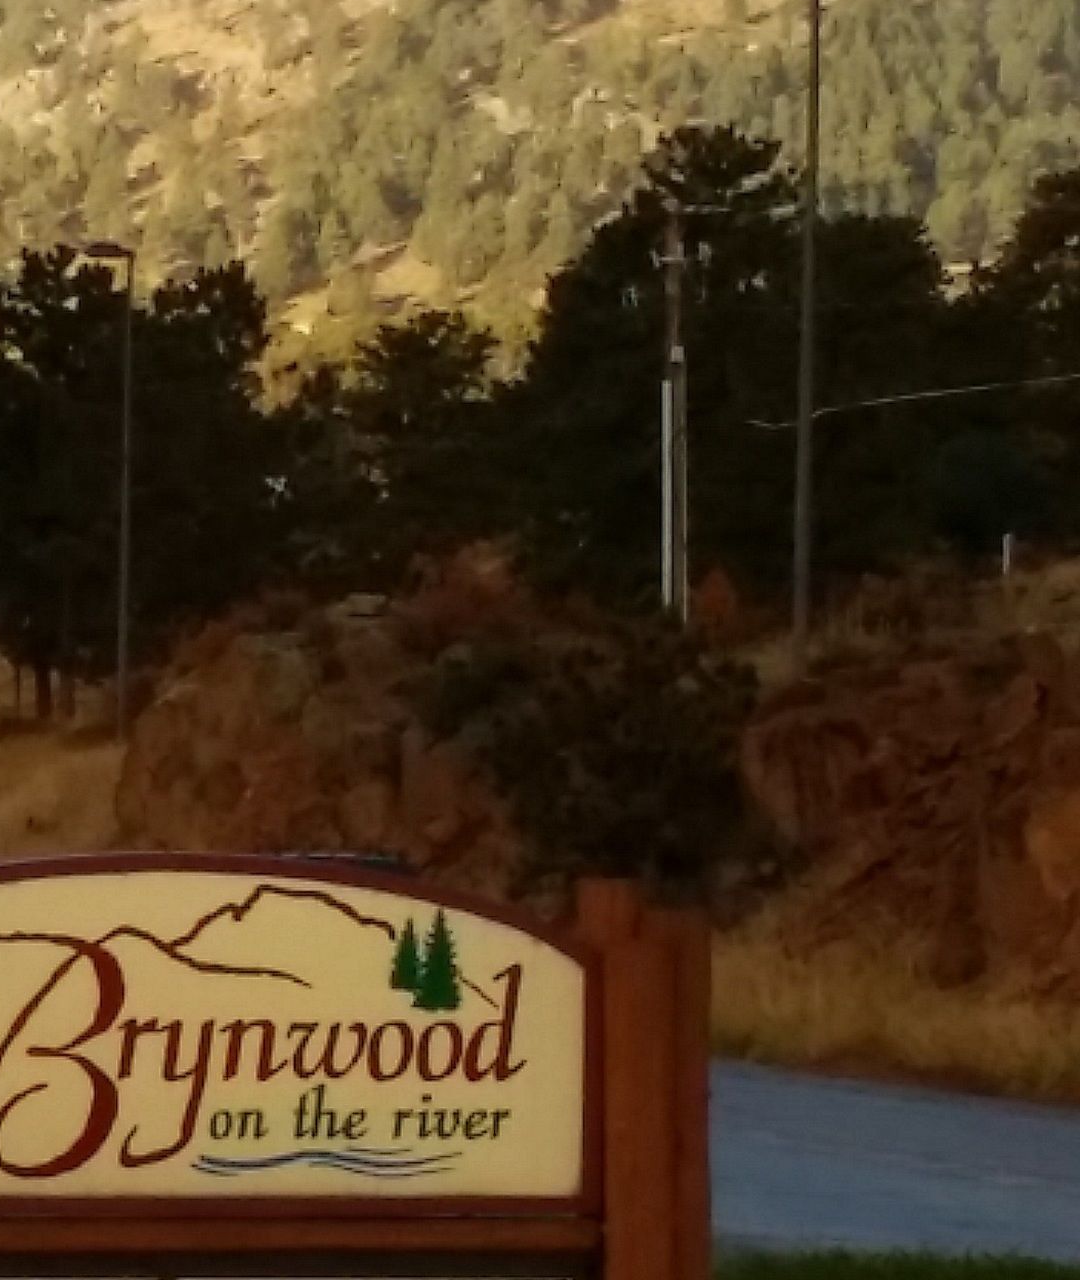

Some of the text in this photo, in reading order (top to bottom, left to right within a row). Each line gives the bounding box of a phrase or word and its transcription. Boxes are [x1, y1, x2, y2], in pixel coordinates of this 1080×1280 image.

[208, 1083, 512, 1140] on the river
